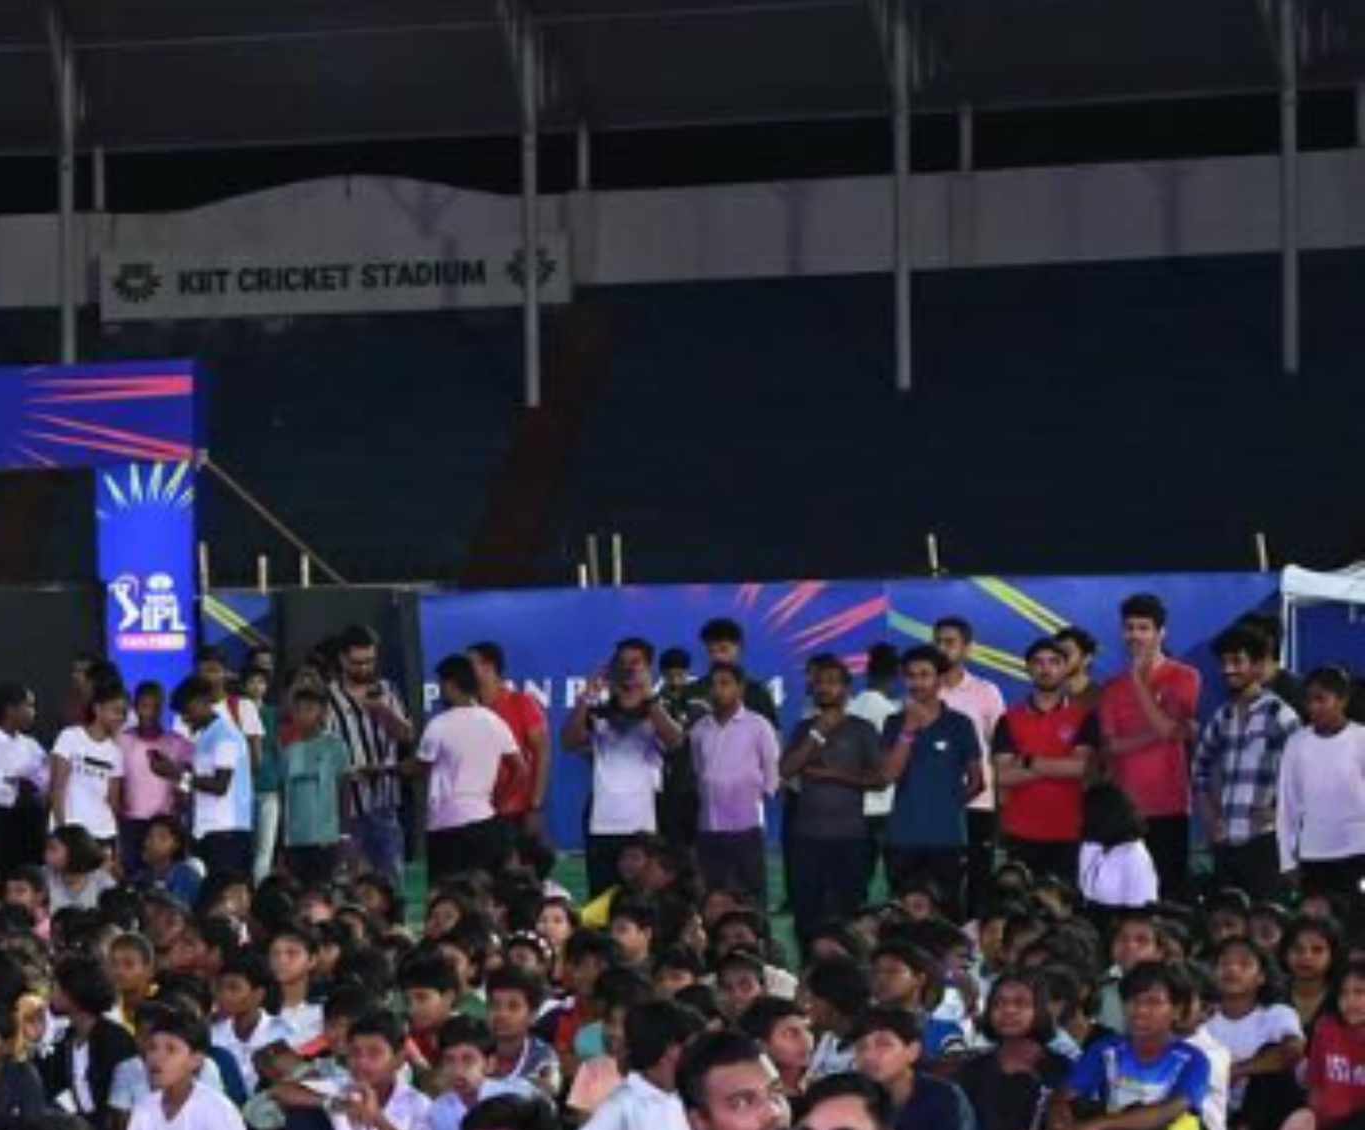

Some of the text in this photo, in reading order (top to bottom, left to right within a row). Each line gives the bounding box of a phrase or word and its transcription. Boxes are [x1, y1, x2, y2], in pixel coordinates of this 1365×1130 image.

[236, 263, 352, 293] CRICKET
[360, 258, 486, 289] STADIUM
[141, 604, 187, 631] IPL
